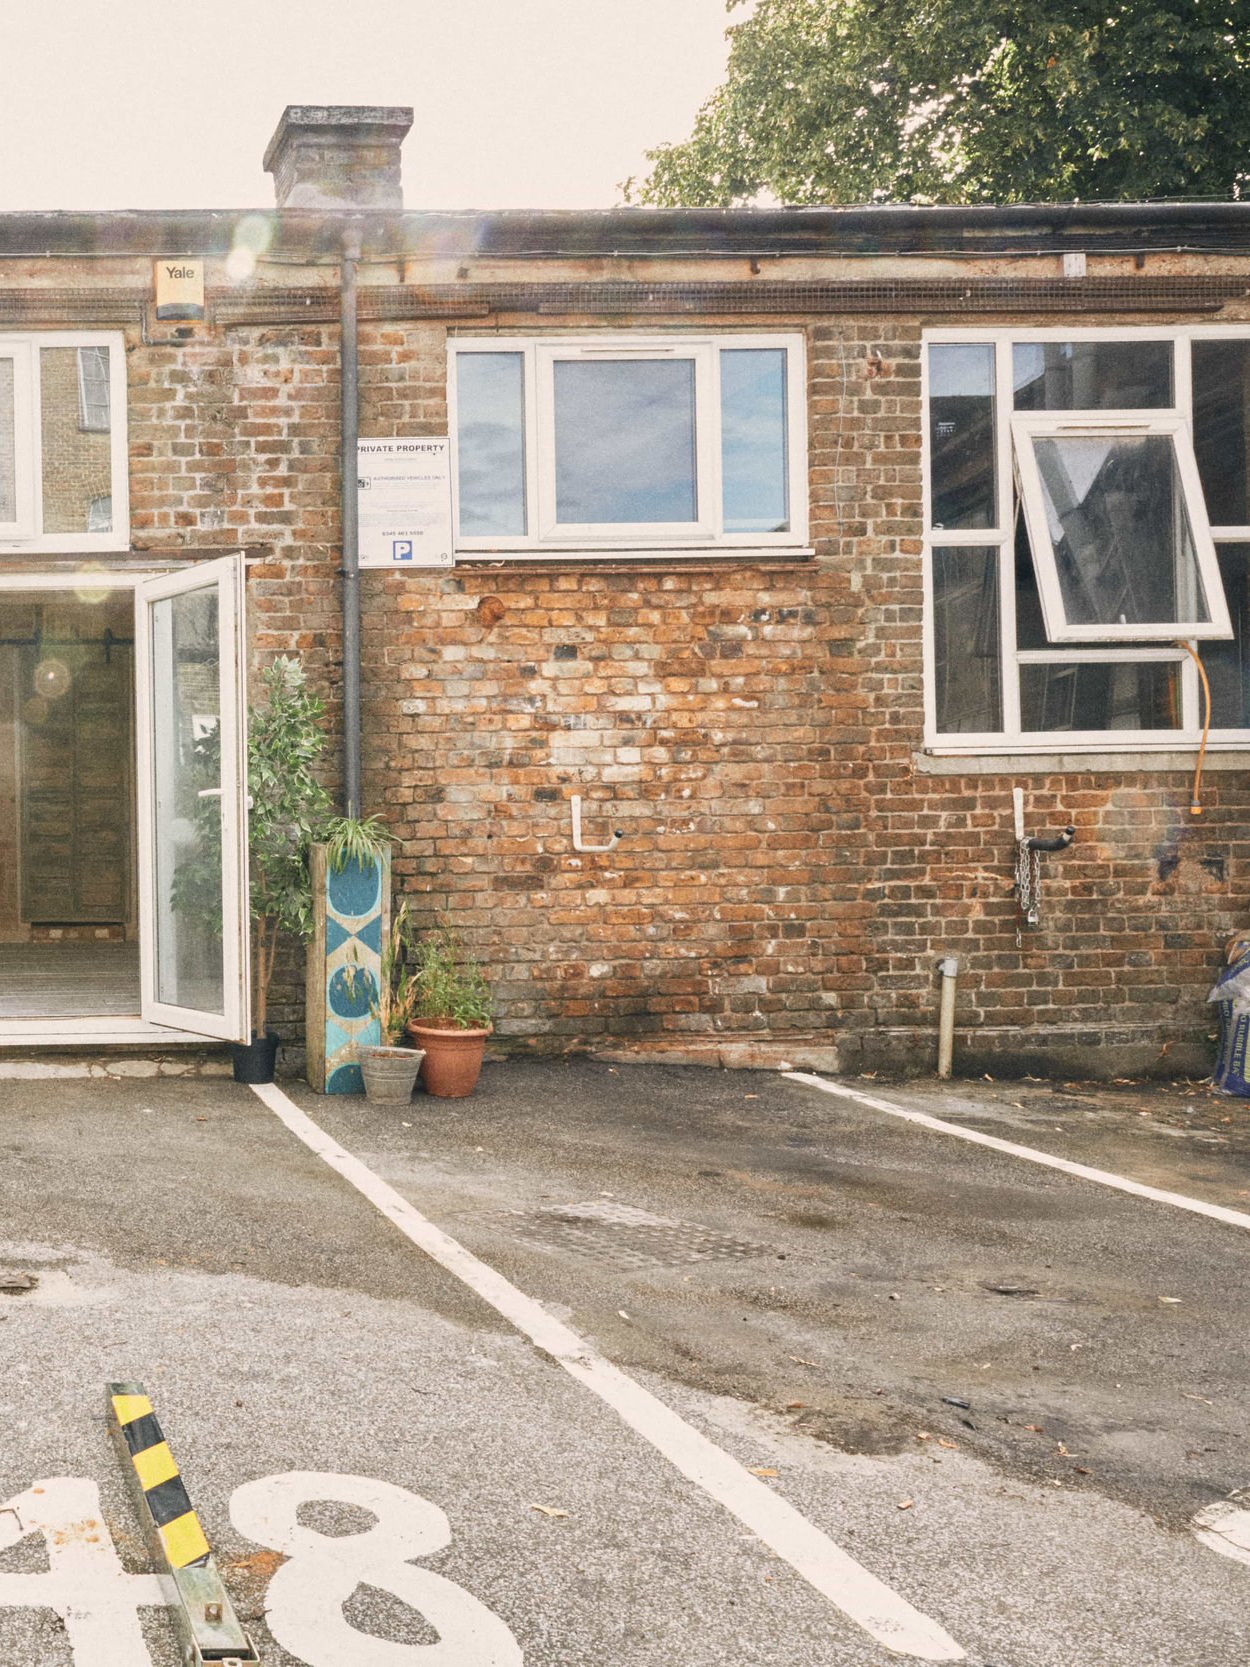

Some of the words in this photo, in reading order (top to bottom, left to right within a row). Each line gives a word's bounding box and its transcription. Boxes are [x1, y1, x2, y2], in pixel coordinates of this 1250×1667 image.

[166, 266, 195, 279] Yale
[357, 445, 394, 453] RIVATE
[396, 444, 445, 452] PROPERTY
